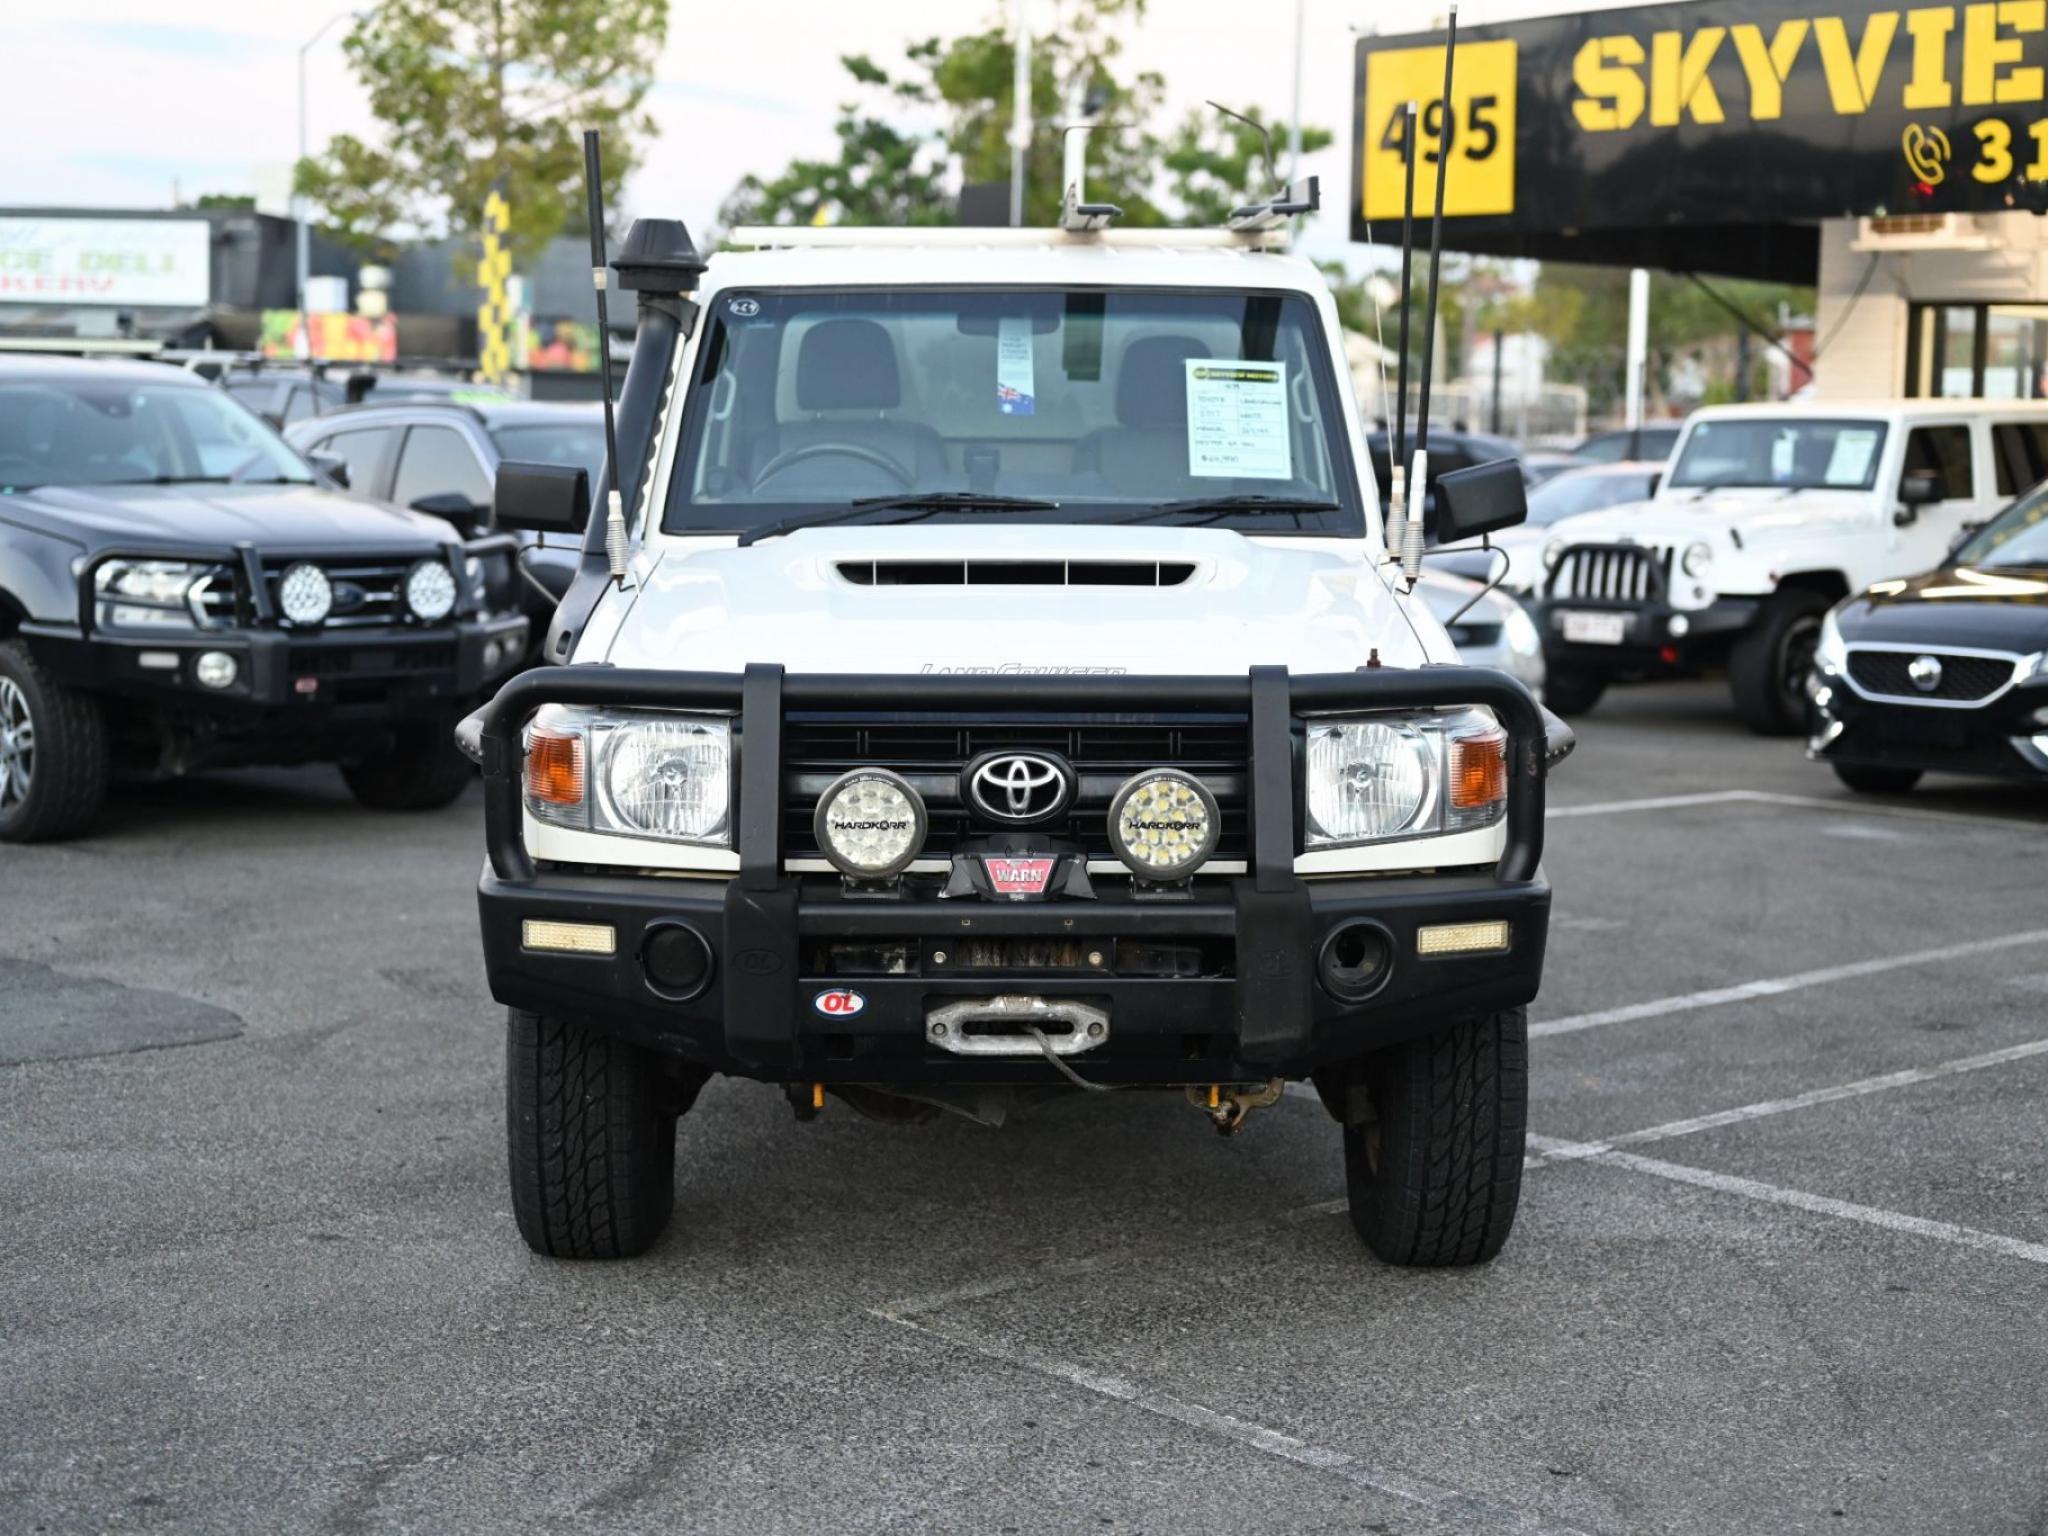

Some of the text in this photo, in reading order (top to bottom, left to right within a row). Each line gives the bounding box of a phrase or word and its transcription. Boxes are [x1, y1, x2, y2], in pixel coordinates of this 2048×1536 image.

[1571, 0, 2045, 131] SKYVIE
[1379, 96, 1498, 164] 495
[1972, 117, 2048, 183] 31
[834, 820, 907, 832] HARDKORR
[1128, 820, 1201, 832] HARDKORR
[995, 867, 1044, 882] WARN
